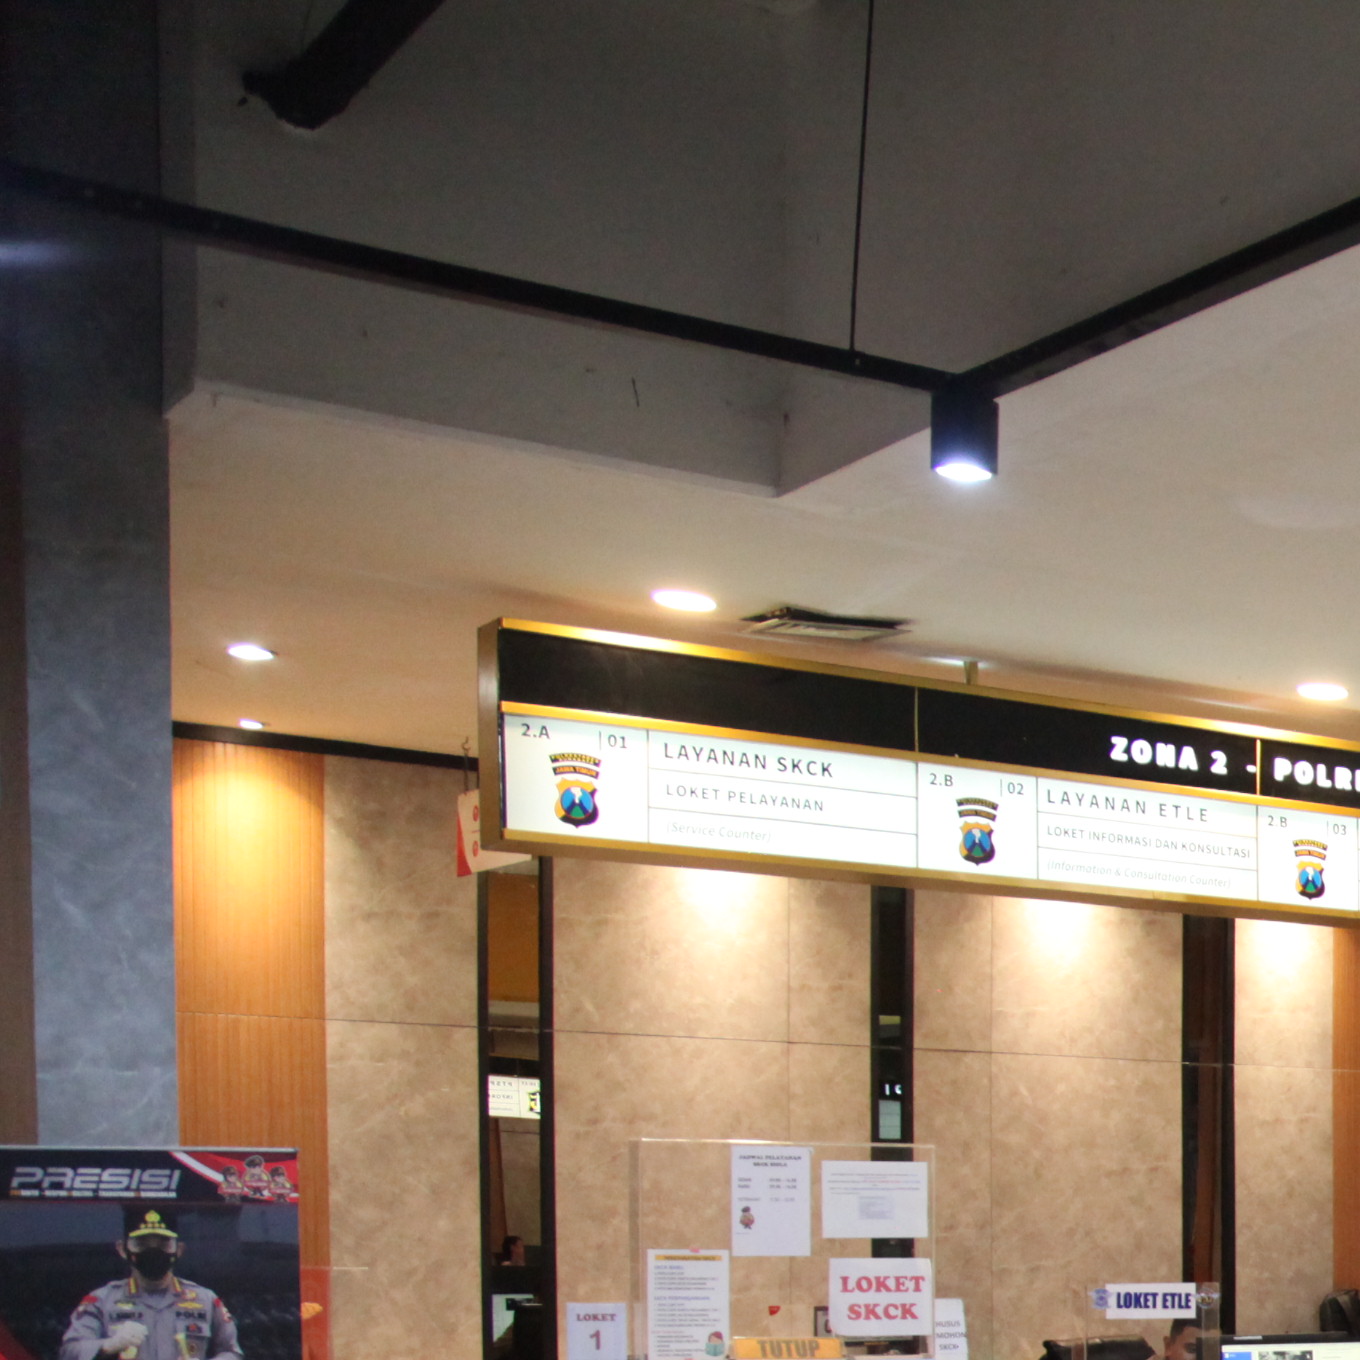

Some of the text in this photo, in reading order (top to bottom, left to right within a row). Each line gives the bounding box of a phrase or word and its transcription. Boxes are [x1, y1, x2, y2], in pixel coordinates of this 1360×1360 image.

[521, 723, 550, 739] 2.A
[607, 735, 627, 749] 01
[664, 742, 833, 778] LAYANAN SKCK
[1109, 736, 1198, 771] ZONA
[1210, 751, 1228, 774] 2
[929, 774, 954, 787] 2.B
[1007, 782, 1024, 795] 02
[666, 784, 824, 811] LOKET PELAYANAN
[1047, 789, 1208, 822] LAYANAN ETLE
[1333, 824, 1347, 835] 03
[1047, 826, 1250, 858] LOKET INFORMASI DAN KONSULTASI
[11, 1166, 181, 1189] PRESISI
[839, 1275, 925, 1293] LOKET
[1116, 1292, 1191, 1309] LOKET ETLE
[576, 1313, 616, 1322] LOKET
[847, 1303, 919, 1321] SKCK
[589, 1330, 602, 1350] 1
[757, 1339, 820, 1359] TUTUP
